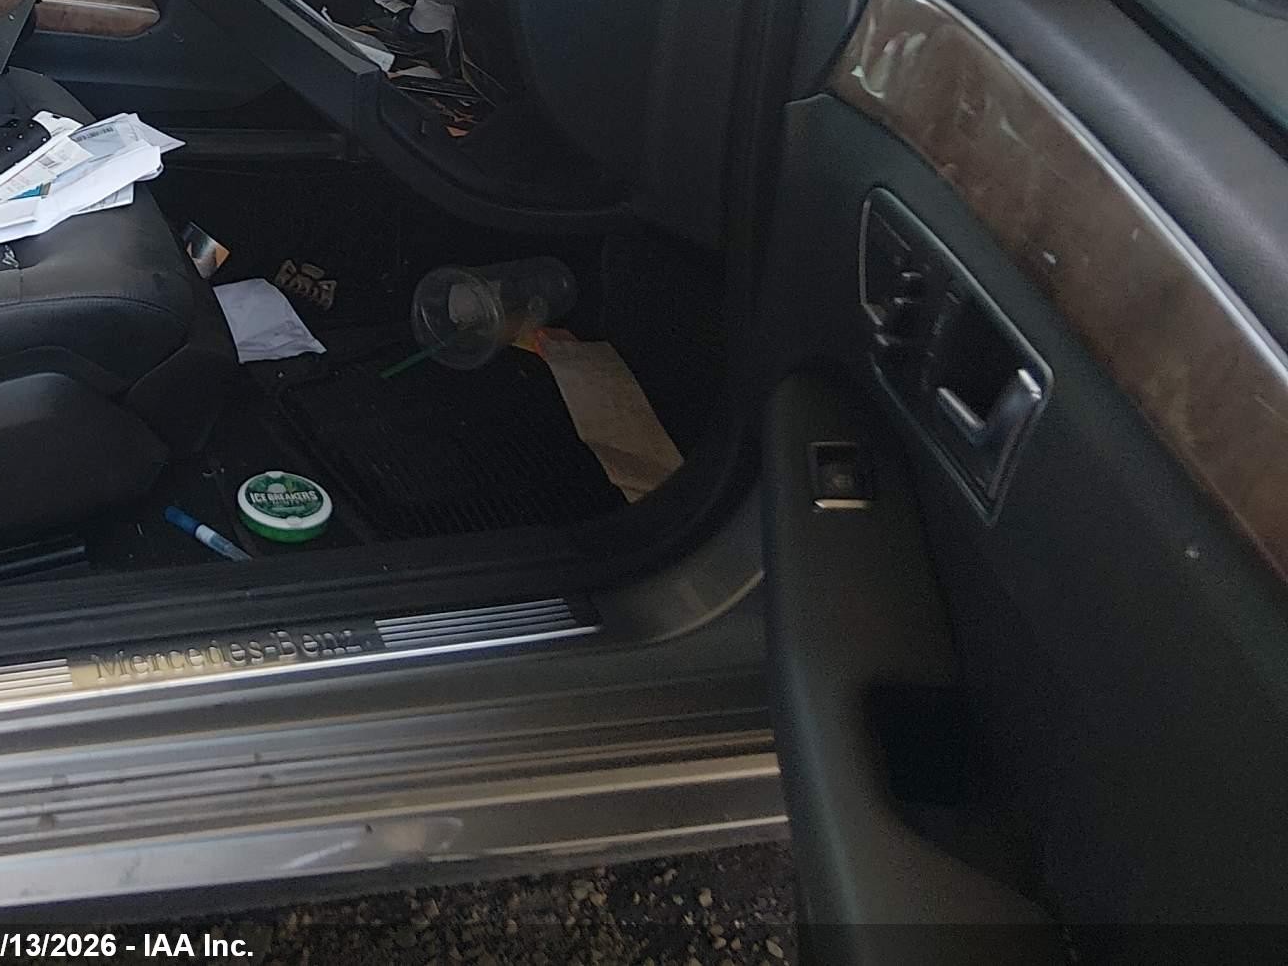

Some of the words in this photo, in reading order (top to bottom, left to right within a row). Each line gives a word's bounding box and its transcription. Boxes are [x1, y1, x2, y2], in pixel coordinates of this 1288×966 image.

[249, 492, 267, 503] ICE
[267, 490, 318, 502] BREAKERS
[91, 629, 363, 682] Mercedes-Benz
